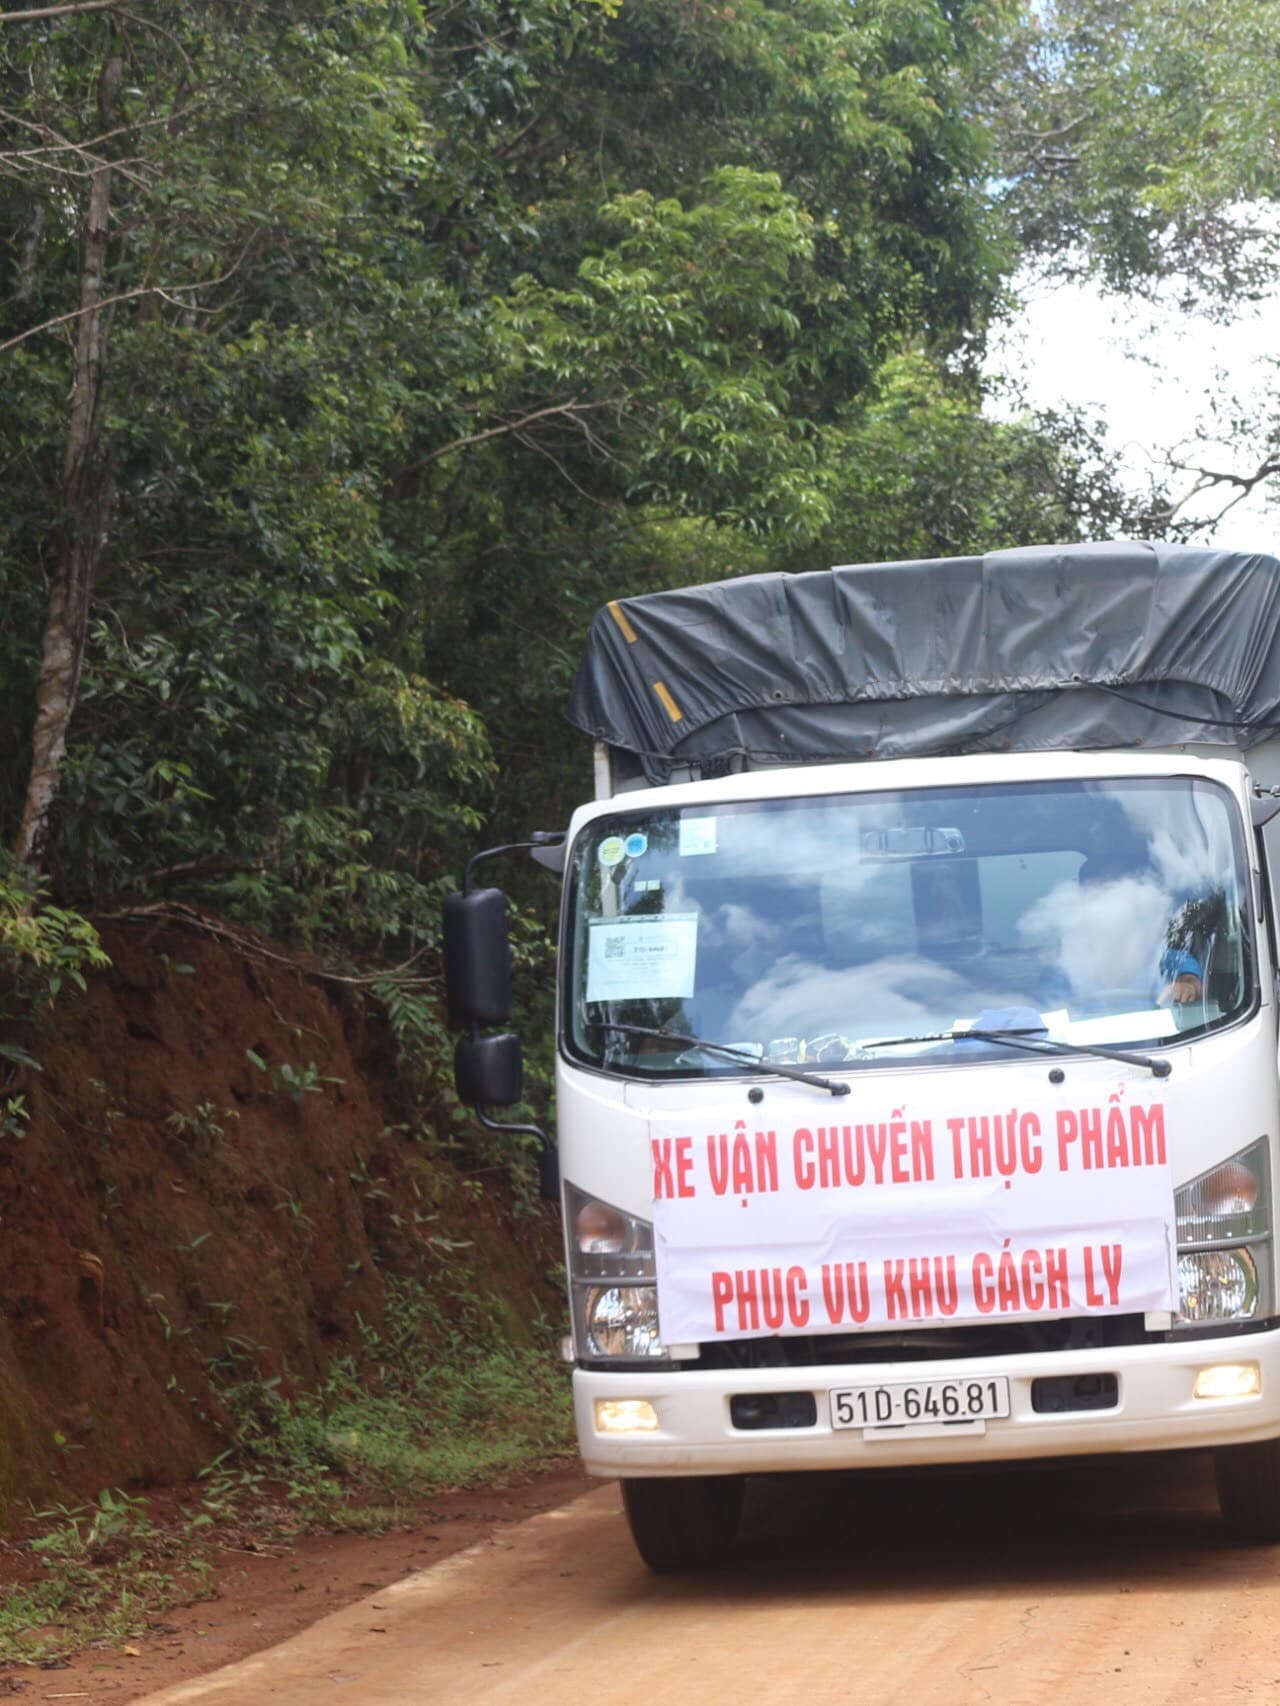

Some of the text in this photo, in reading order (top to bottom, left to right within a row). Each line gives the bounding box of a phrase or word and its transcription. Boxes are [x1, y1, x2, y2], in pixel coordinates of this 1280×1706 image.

[651, 1137, 696, 1200] XE
[706, 1119, 779, 1208] VẬN
[946, 1107, 1043, 1190] THỰC
[883, 1255, 959, 1321] KHU
[972, 1238, 1071, 1314] CÁCH
[1083, 1244, 1123, 1307] LY
[836, 1381, 999, 1424] 51D-646.81
